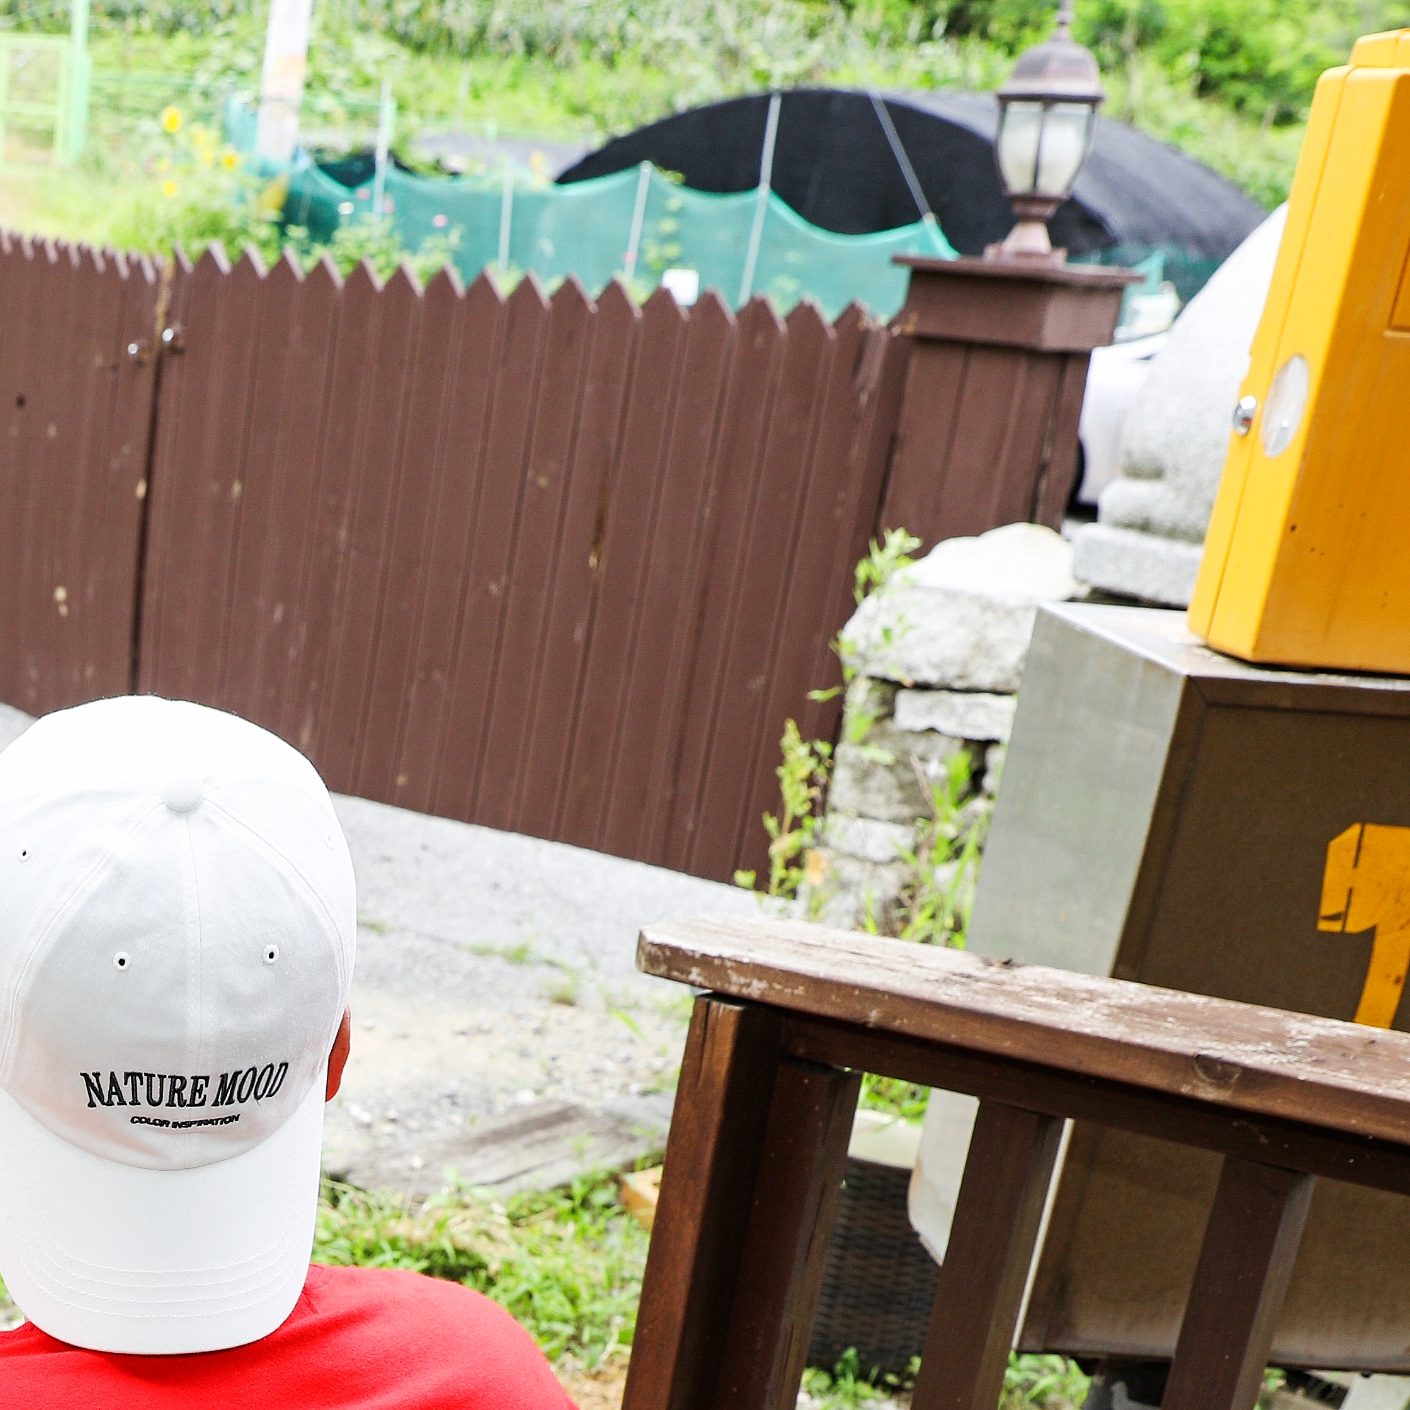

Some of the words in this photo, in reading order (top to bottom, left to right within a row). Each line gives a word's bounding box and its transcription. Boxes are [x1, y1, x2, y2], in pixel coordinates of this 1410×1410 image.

[80, 1071, 210, 1108] NATURE
[211, 1061, 289, 1107] MOOD
[130, 1116, 170, 1128] COLOR
[171, 1114, 240, 1128] INSPIRATION
